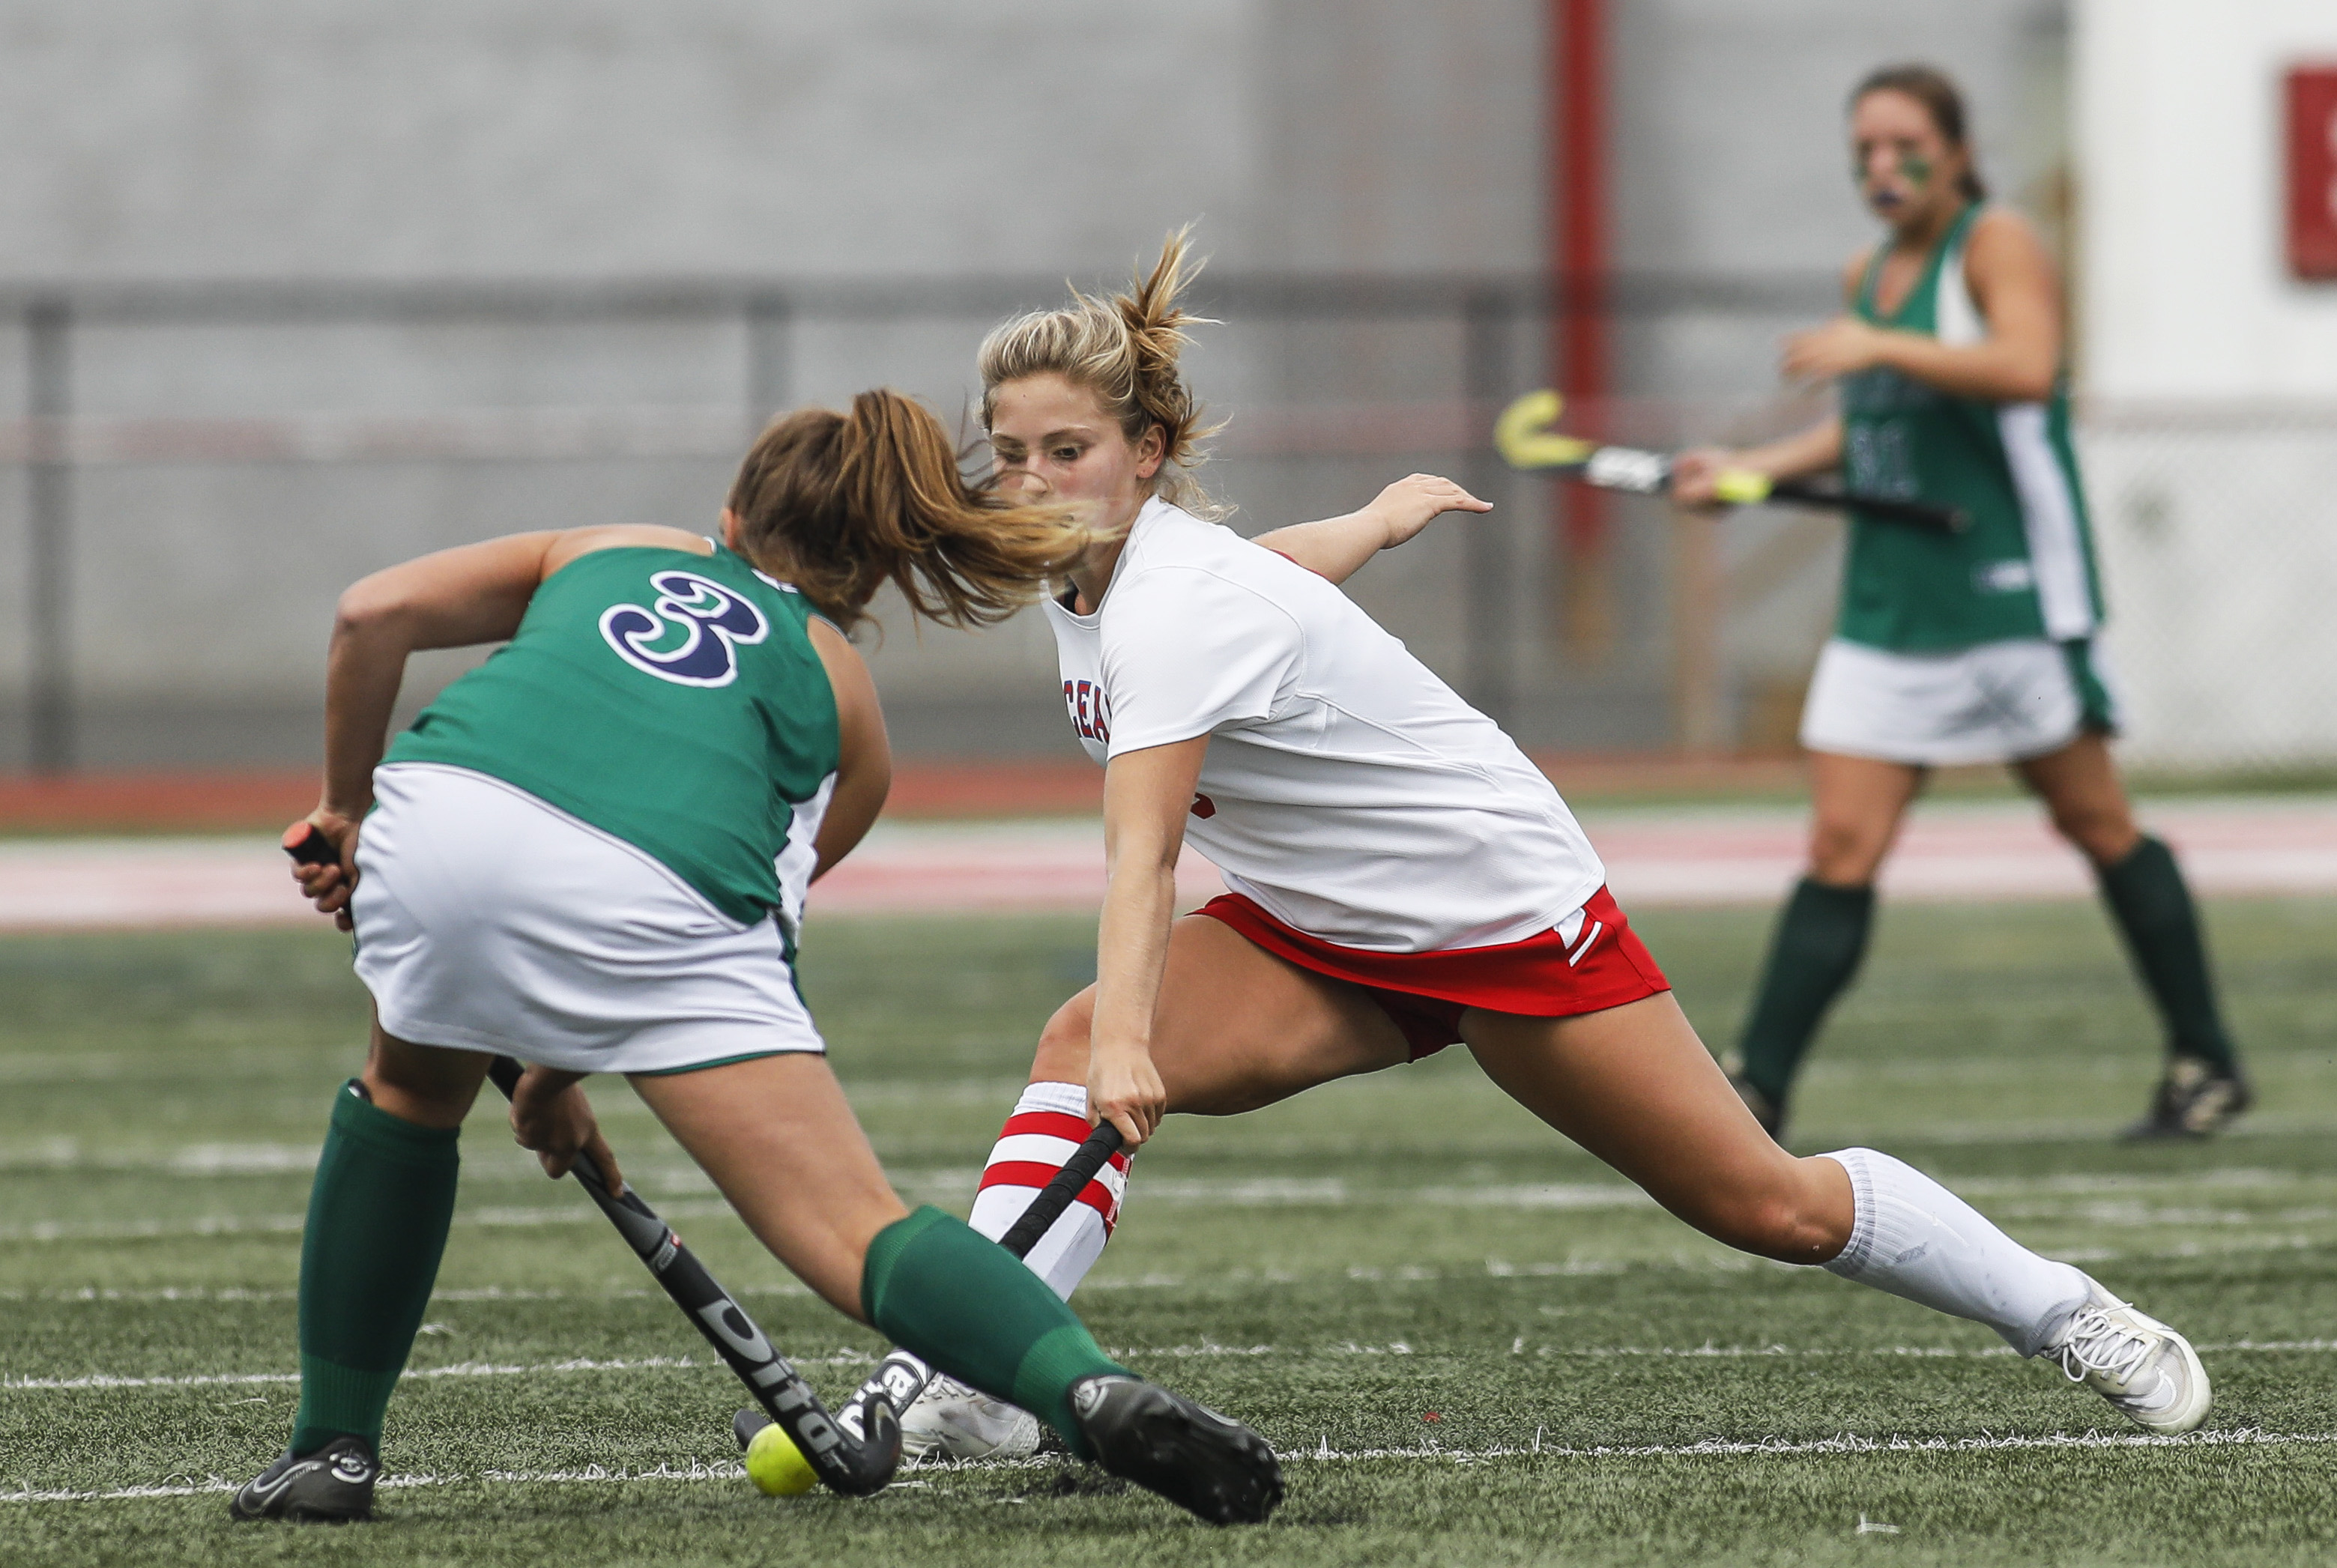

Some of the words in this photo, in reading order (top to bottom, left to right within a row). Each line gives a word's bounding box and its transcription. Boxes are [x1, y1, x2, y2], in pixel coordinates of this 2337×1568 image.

[599, 570, 770, 688] 3
[1064, 679, 1112, 744] CEA
[697, 1298, 841, 1454] Dita
